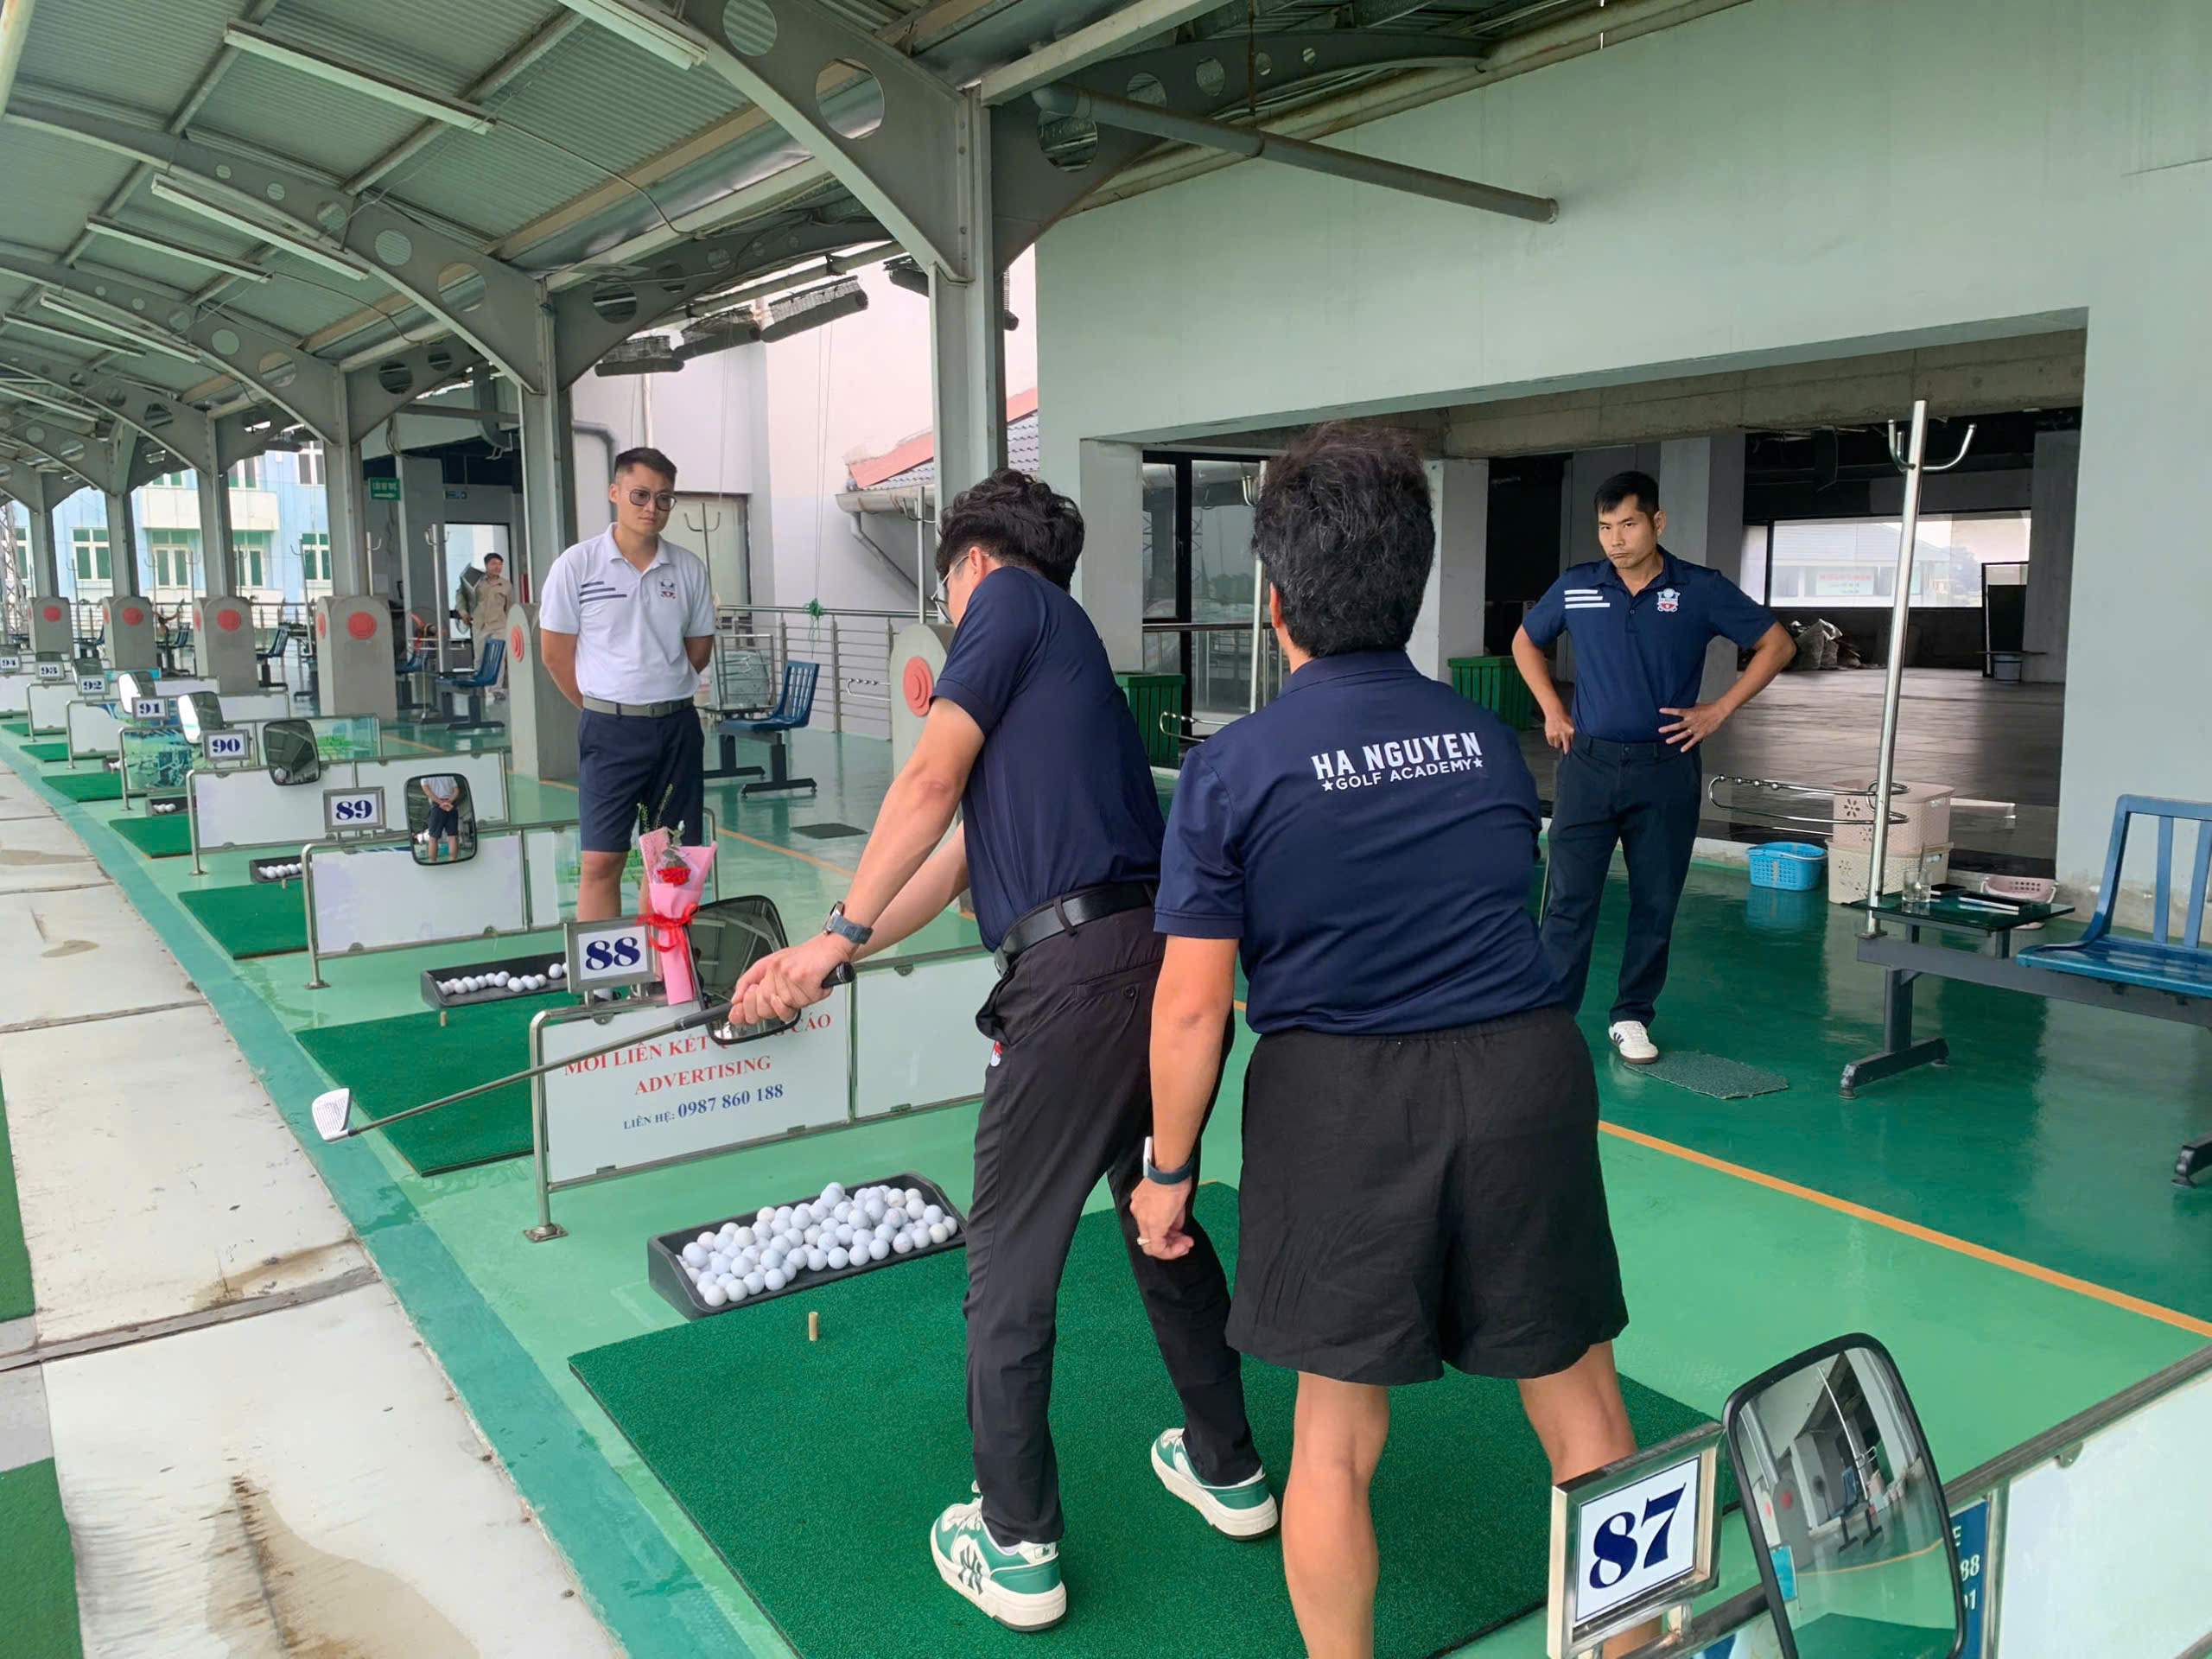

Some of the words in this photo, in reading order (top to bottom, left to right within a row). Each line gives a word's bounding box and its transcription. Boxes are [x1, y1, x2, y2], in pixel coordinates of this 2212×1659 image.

[83, 681, 102, 690] 92
[139, 702, 160, 715] 91
[212, 738, 241, 753] 90
[1311, 749, 1356, 780] HA
[1362, 732, 1483, 772] NGUYEN
[1335, 772, 1382, 791] GOLF
[1389, 758, 1471, 782] ACADEMY
[335, 800, 372, 820] 89
[585, 937, 641, 970] 88
[613, 1042, 663, 1067] LIÊN
[634, 1055, 771, 1095] ADVERTISING
[623, 1115, 652, 1130] LIÊN
[677, 1098, 716, 1118] 0987
[721, 1090, 750, 1109] 860
[756, 1084, 784, 1103] 188
[1589, 1481, 1687, 1590] 87
